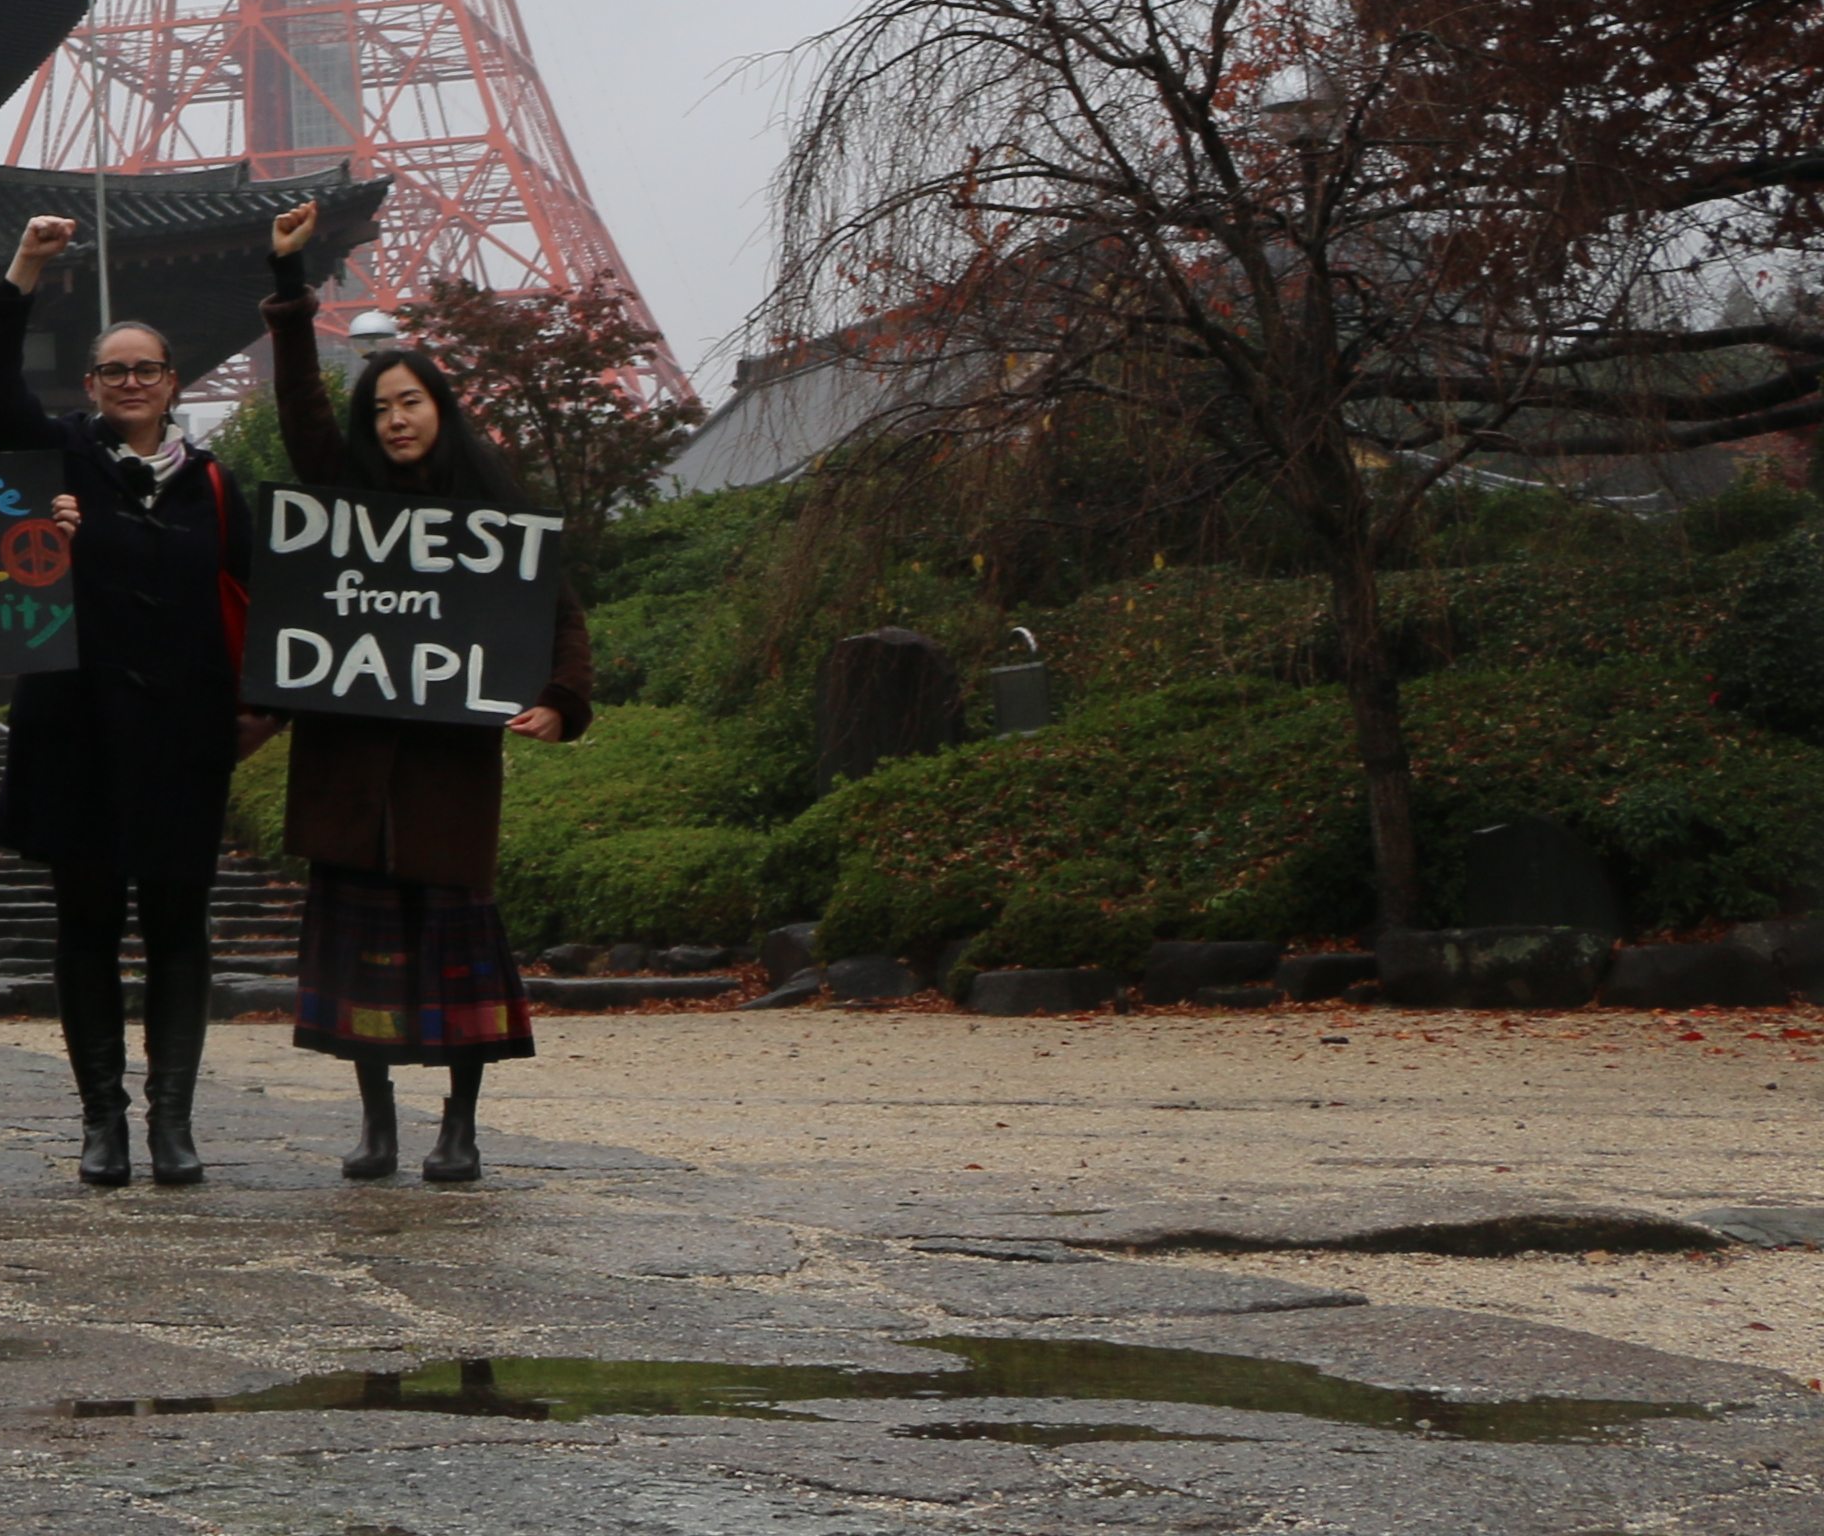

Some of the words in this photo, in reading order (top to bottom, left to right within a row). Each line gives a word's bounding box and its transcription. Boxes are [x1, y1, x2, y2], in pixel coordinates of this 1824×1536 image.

[270, 490, 564, 581] DIVEST
[323, 569, 442, 620] from
[276, 628, 523, 714] DAPL
